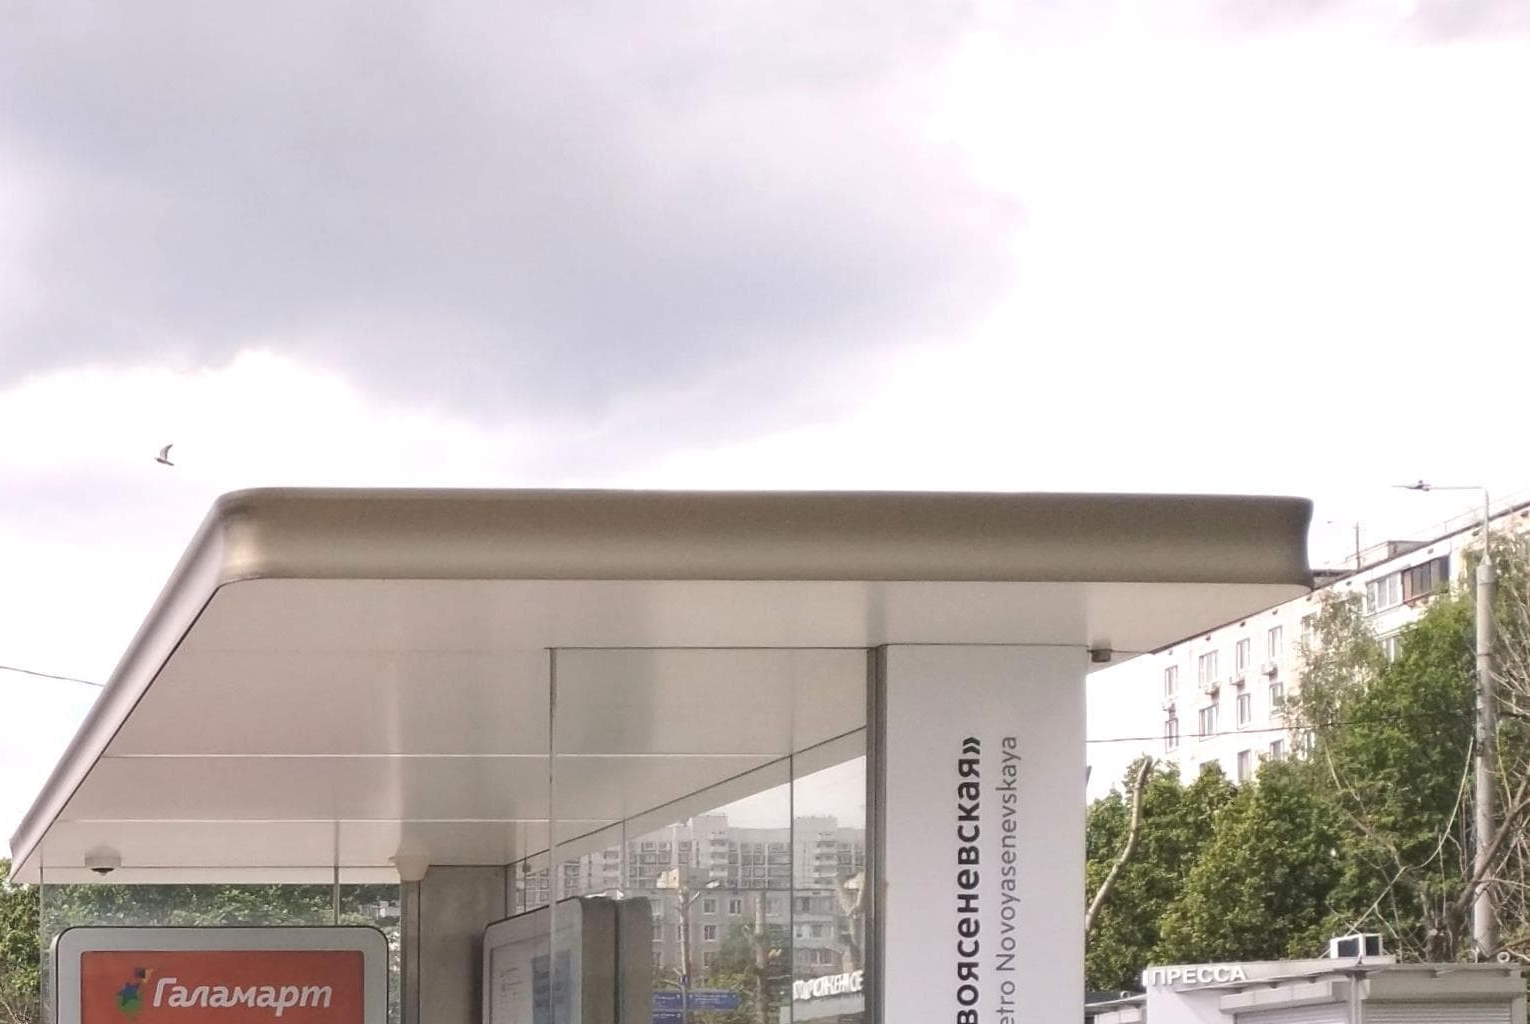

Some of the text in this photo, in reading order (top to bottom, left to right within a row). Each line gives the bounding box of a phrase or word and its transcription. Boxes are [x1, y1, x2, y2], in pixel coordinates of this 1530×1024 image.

[994, 735, 1023, 972] Novoyasenevskaya
[1152, 965, 1247, 985] ПРЕССА
[152, 977, 333, 1017] Галамарт
